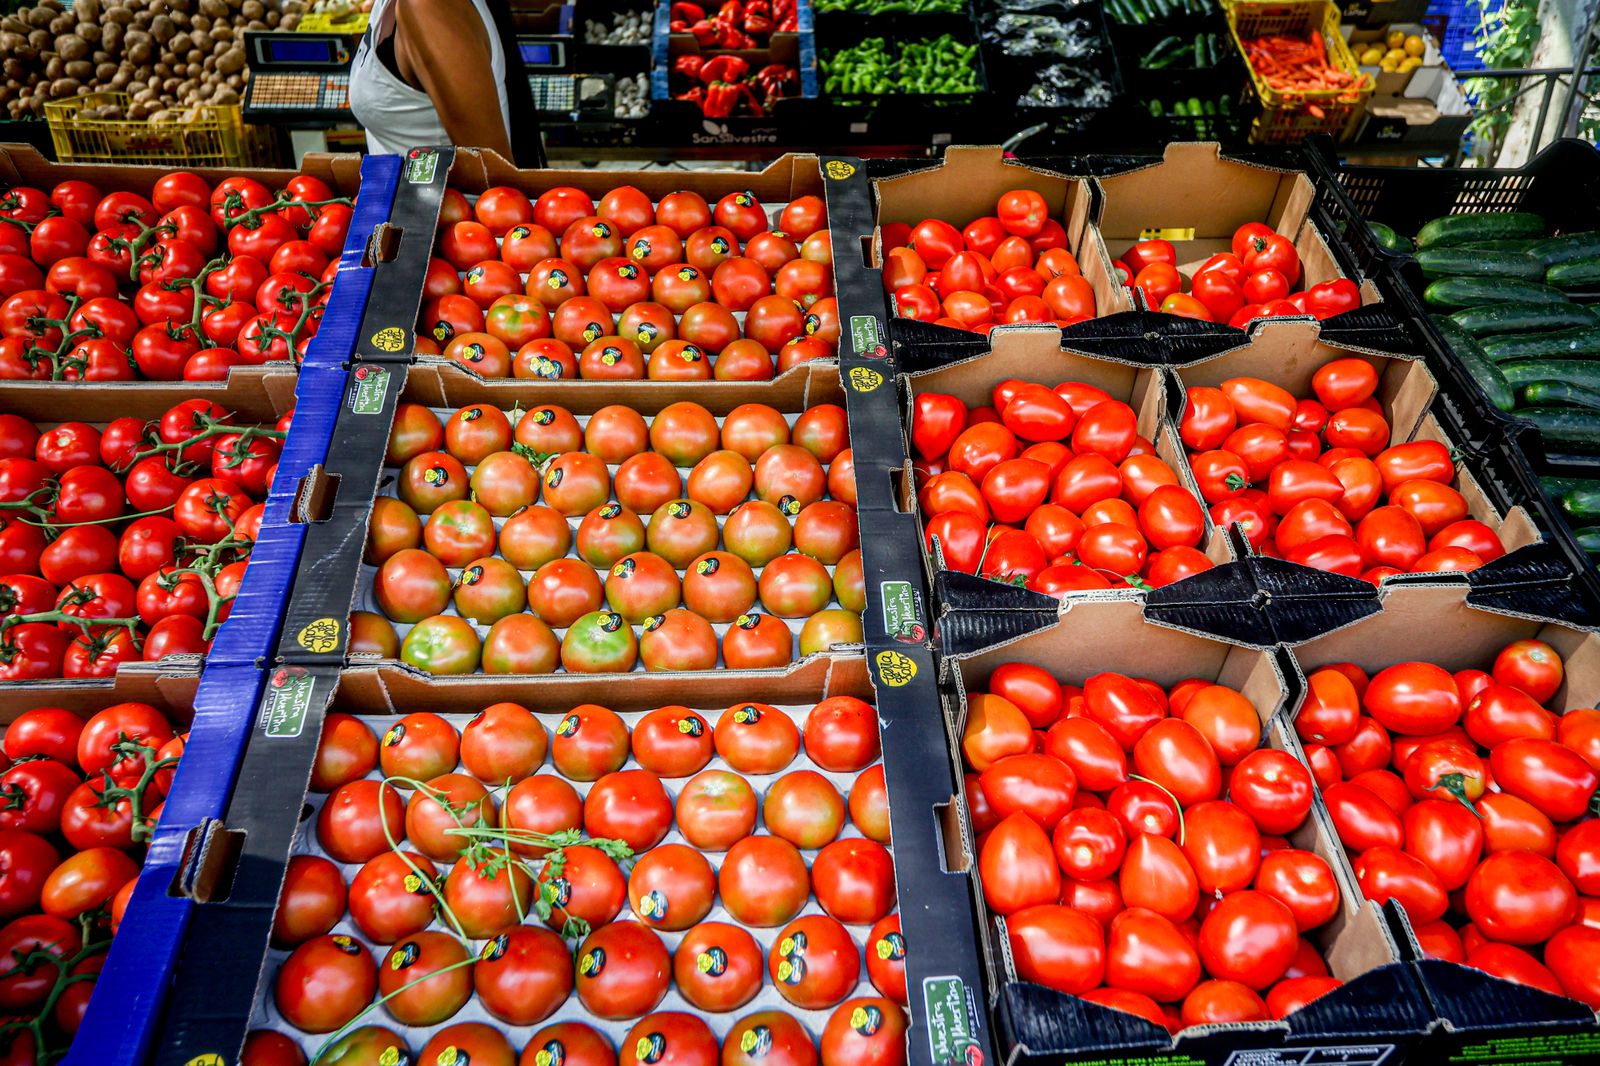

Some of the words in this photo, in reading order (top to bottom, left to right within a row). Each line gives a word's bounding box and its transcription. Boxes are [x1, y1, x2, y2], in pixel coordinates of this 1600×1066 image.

[692, 133, 777, 144] SanSilvestre
[854, 326, 865, 349] Nuestra
[357, 383, 373, 412] Huertina
[372, 375, 387, 402] Nuestra
[886, 596, 900, 630] Nuestra
[899, 584, 913, 620] Huertina
[270, 692, 293, 734] Huertina
[289, 681, 310, 719] Nuestra
[946, 980, 968, 1037] Huertina
[931, 1000, 950, 1054] Nuestra
